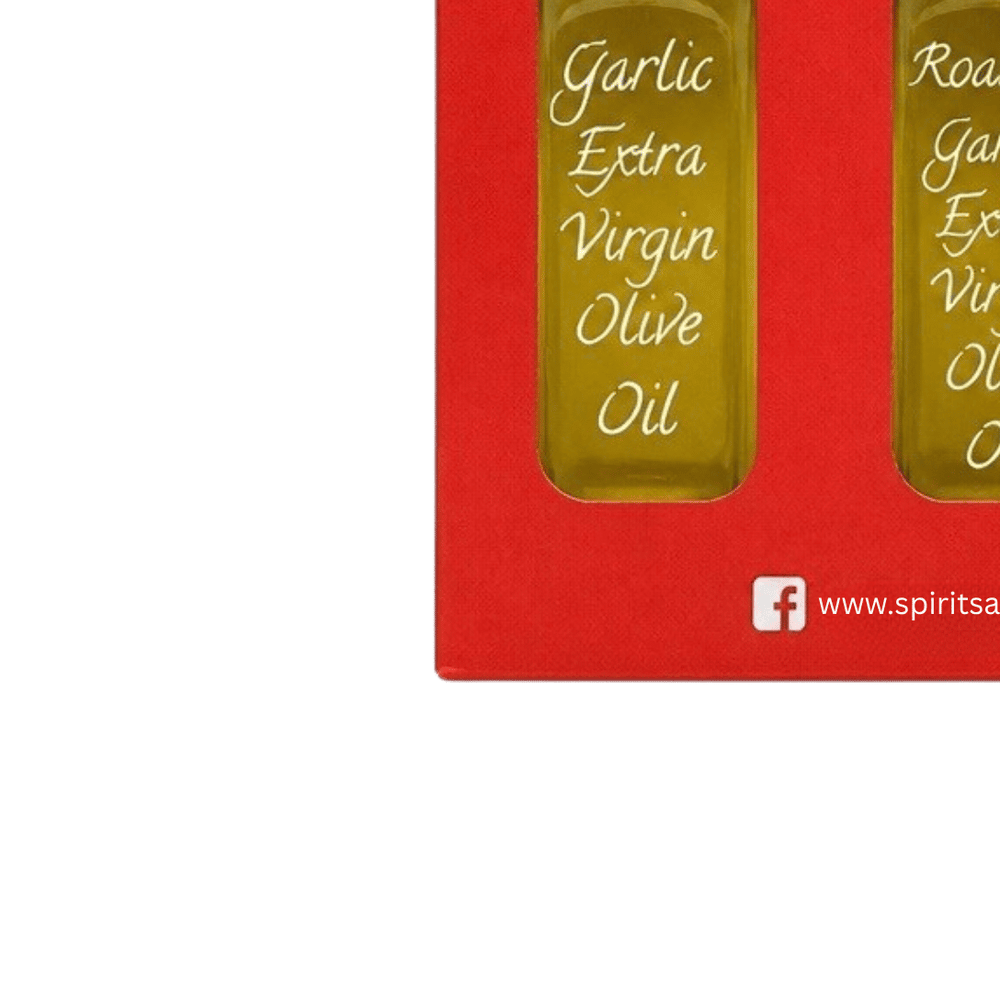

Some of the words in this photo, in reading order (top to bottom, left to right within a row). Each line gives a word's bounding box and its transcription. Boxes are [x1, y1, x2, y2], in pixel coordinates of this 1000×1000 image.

[550, 38, 714, 127] Garlic
[568, 122, 708, 198] Extra
[560, 207, 718, 289] Virgin
[576, 291, 703, 346] Olive
[598, 380, 680, 436] Oil
